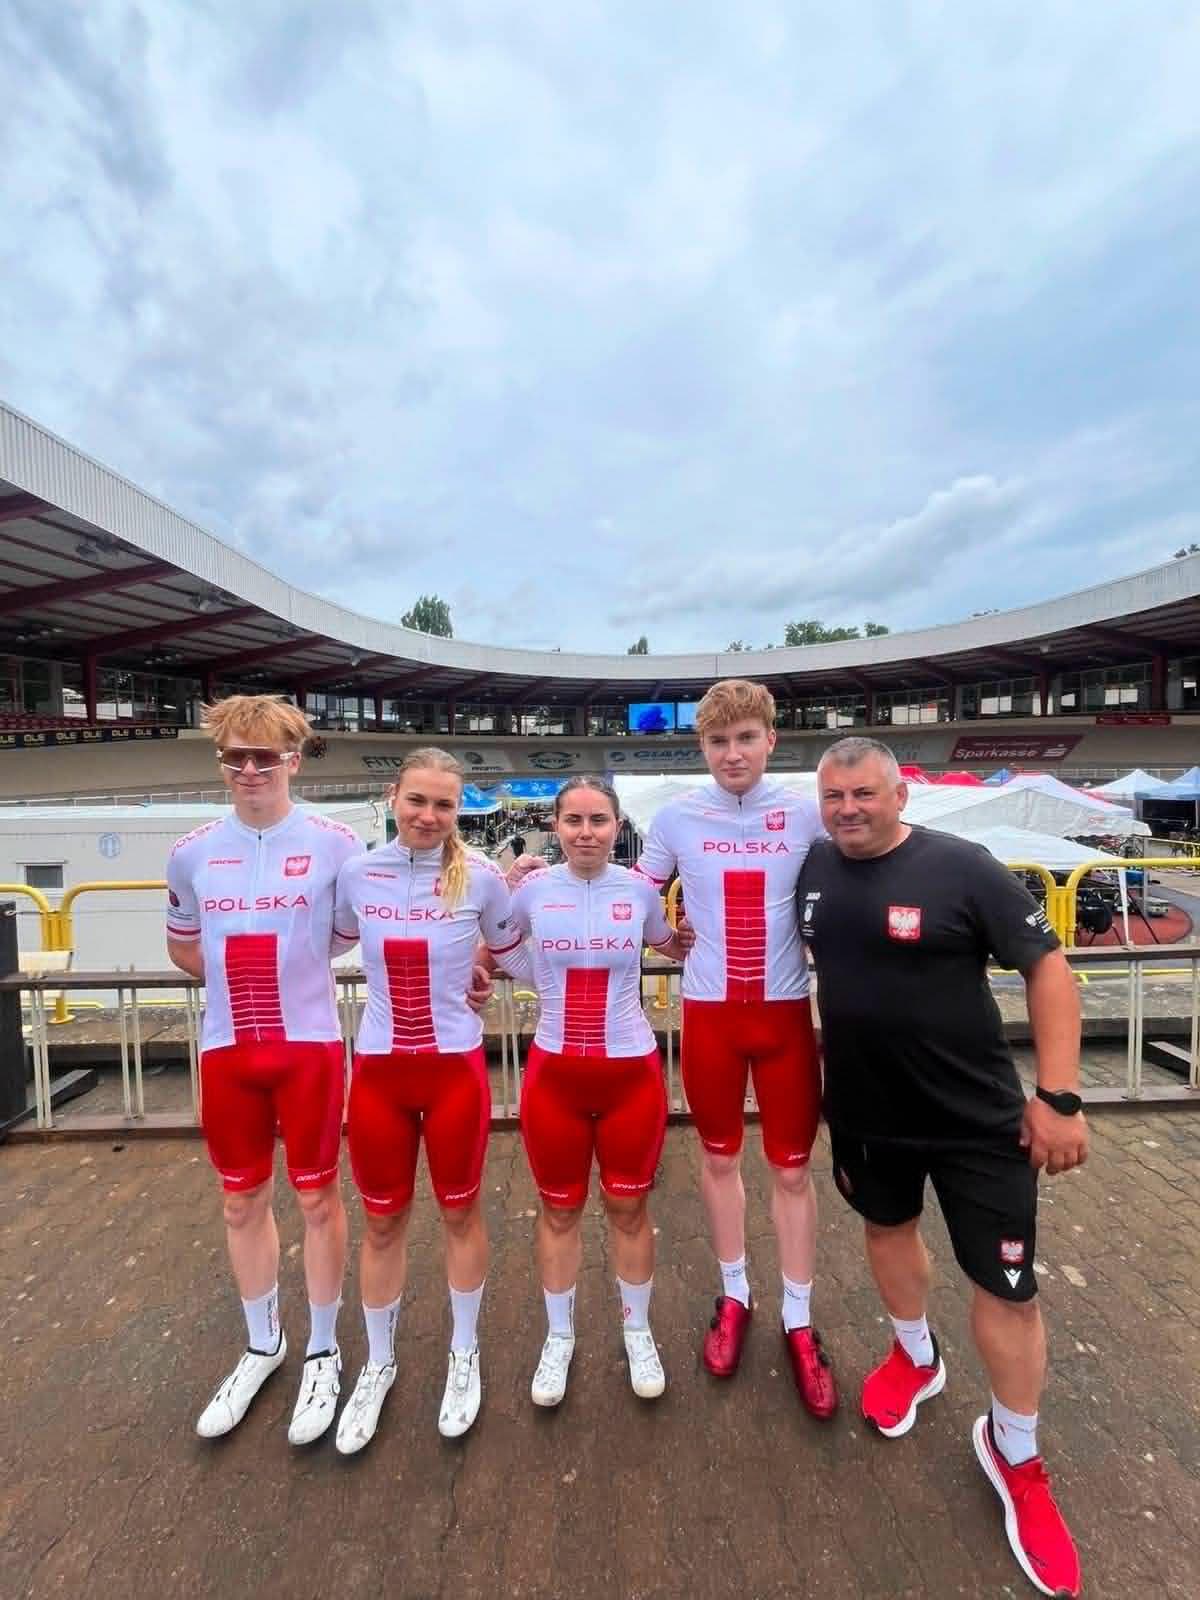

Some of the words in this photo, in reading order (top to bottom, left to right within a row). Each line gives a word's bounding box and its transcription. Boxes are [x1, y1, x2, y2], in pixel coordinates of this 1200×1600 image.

[954, 745, 1038, 760] Sparkasse
[703, 841, 790, 854] POLSKA
[204, 895, 309, 913] POLSKA
[365, 905, 455, 921] POLSKA
[542, 938, 636, 951] POLSKA
